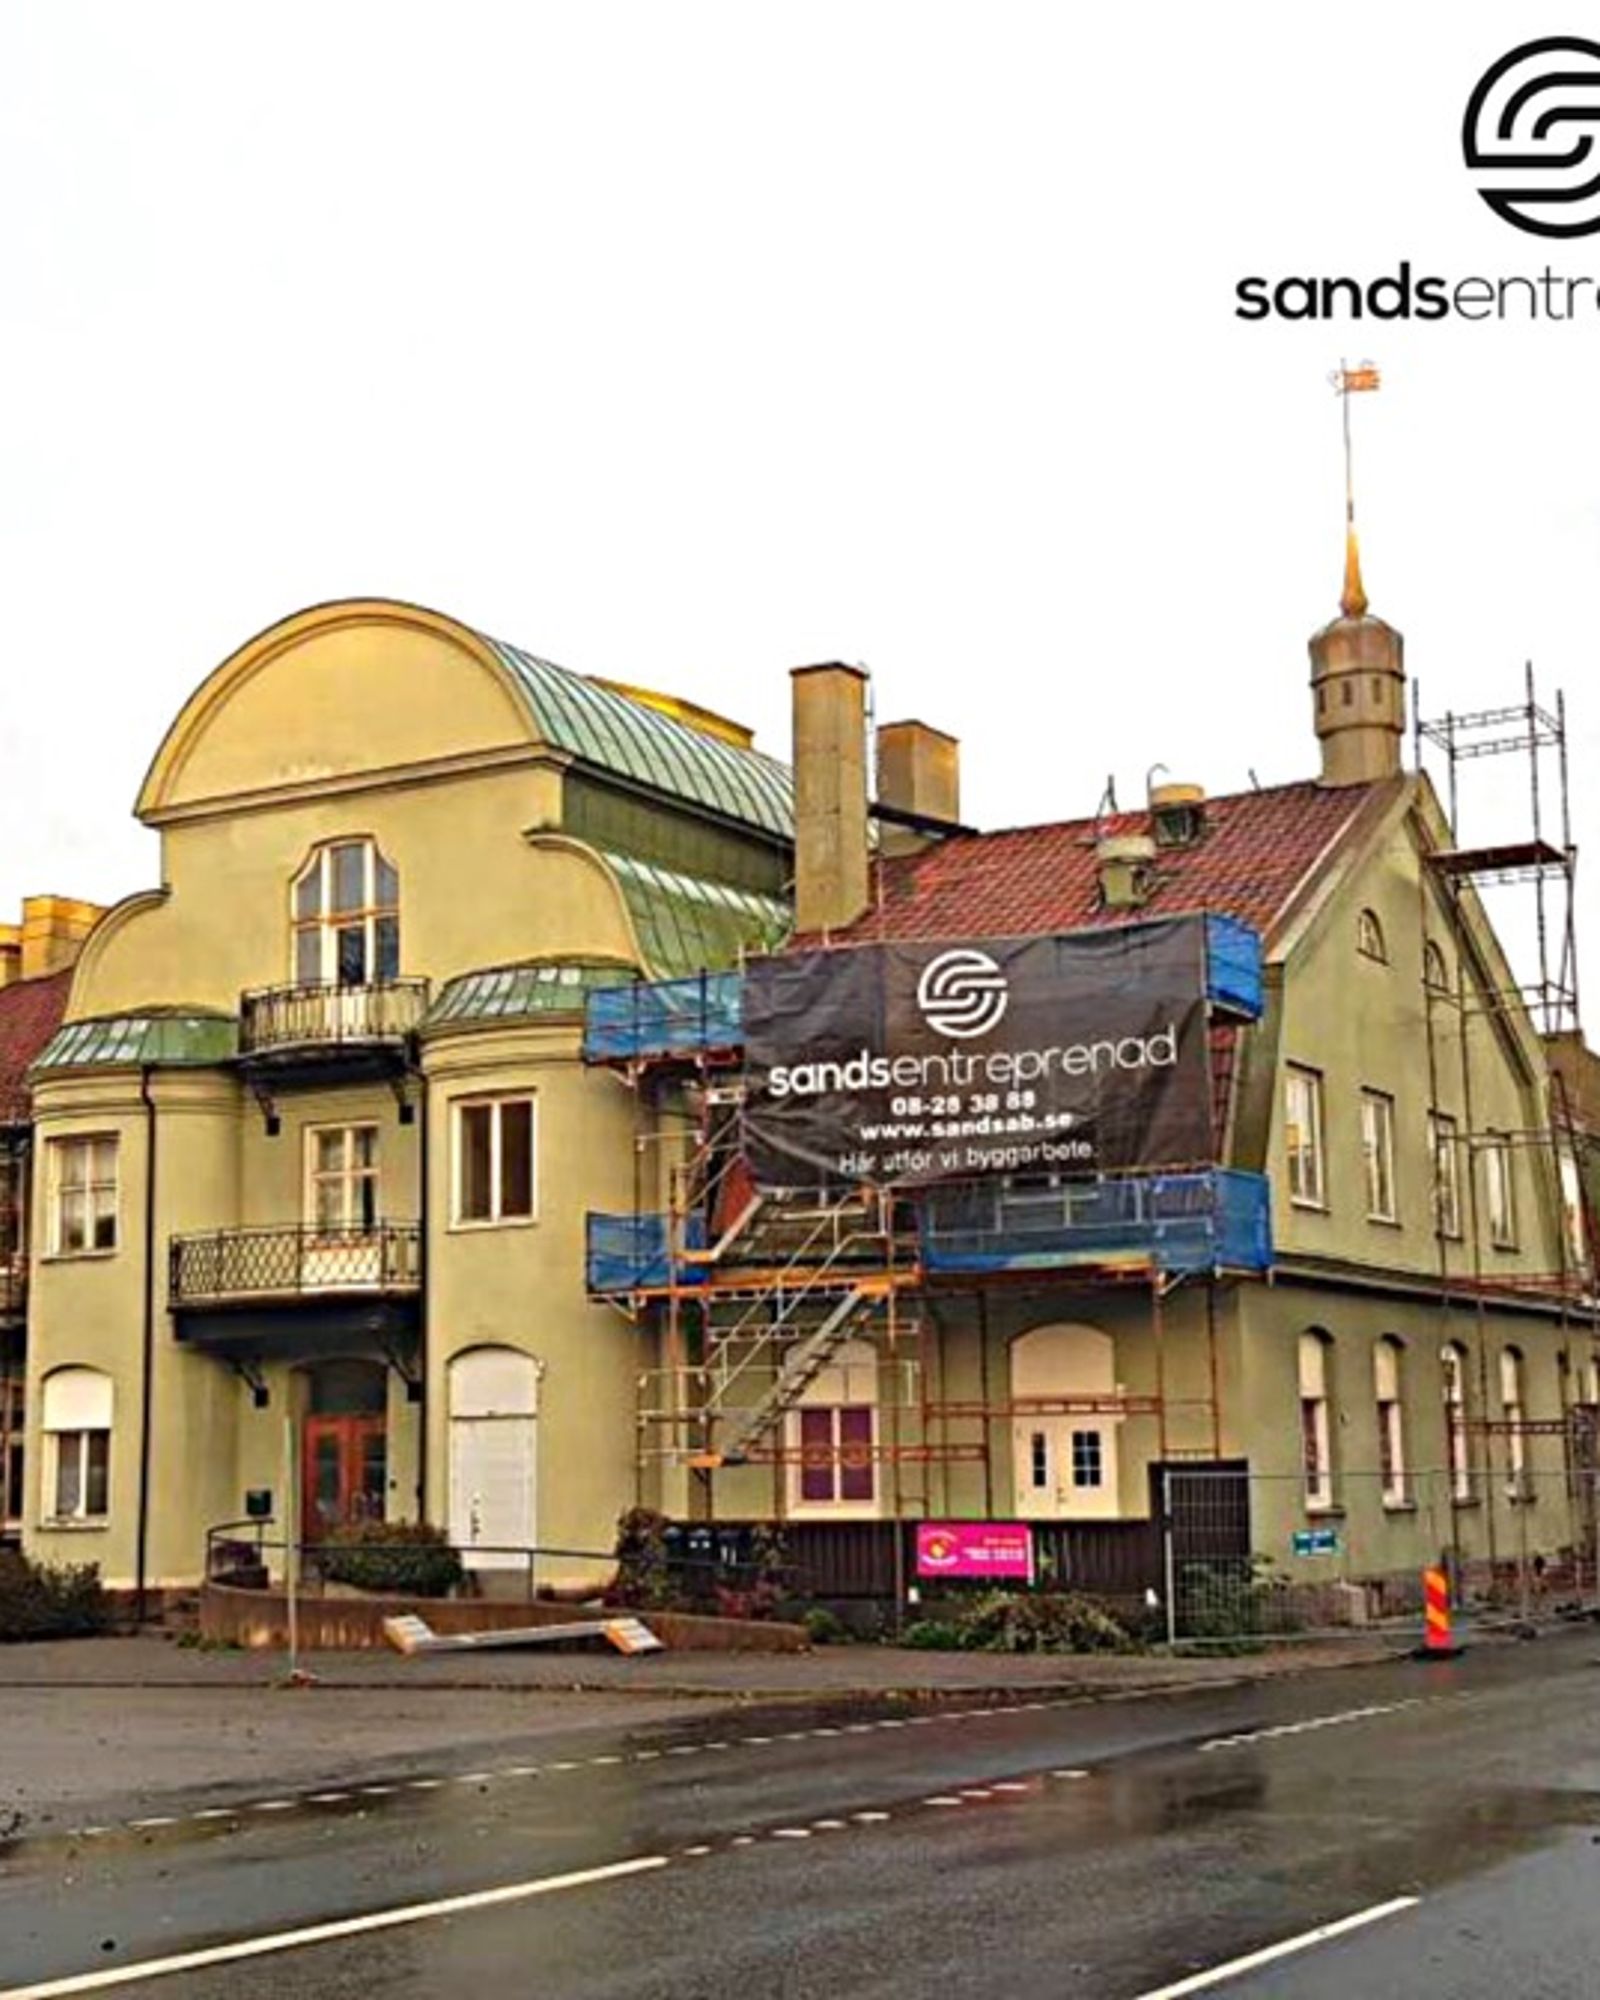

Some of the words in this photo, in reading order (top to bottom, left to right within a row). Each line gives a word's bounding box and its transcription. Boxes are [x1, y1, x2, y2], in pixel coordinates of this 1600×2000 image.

[768, 1024, 1177, 1096] sandsentreprenad
[860, 1112, 1073, 1141] www.sandsab.se
[940, 1149, 959, 1170] vi
